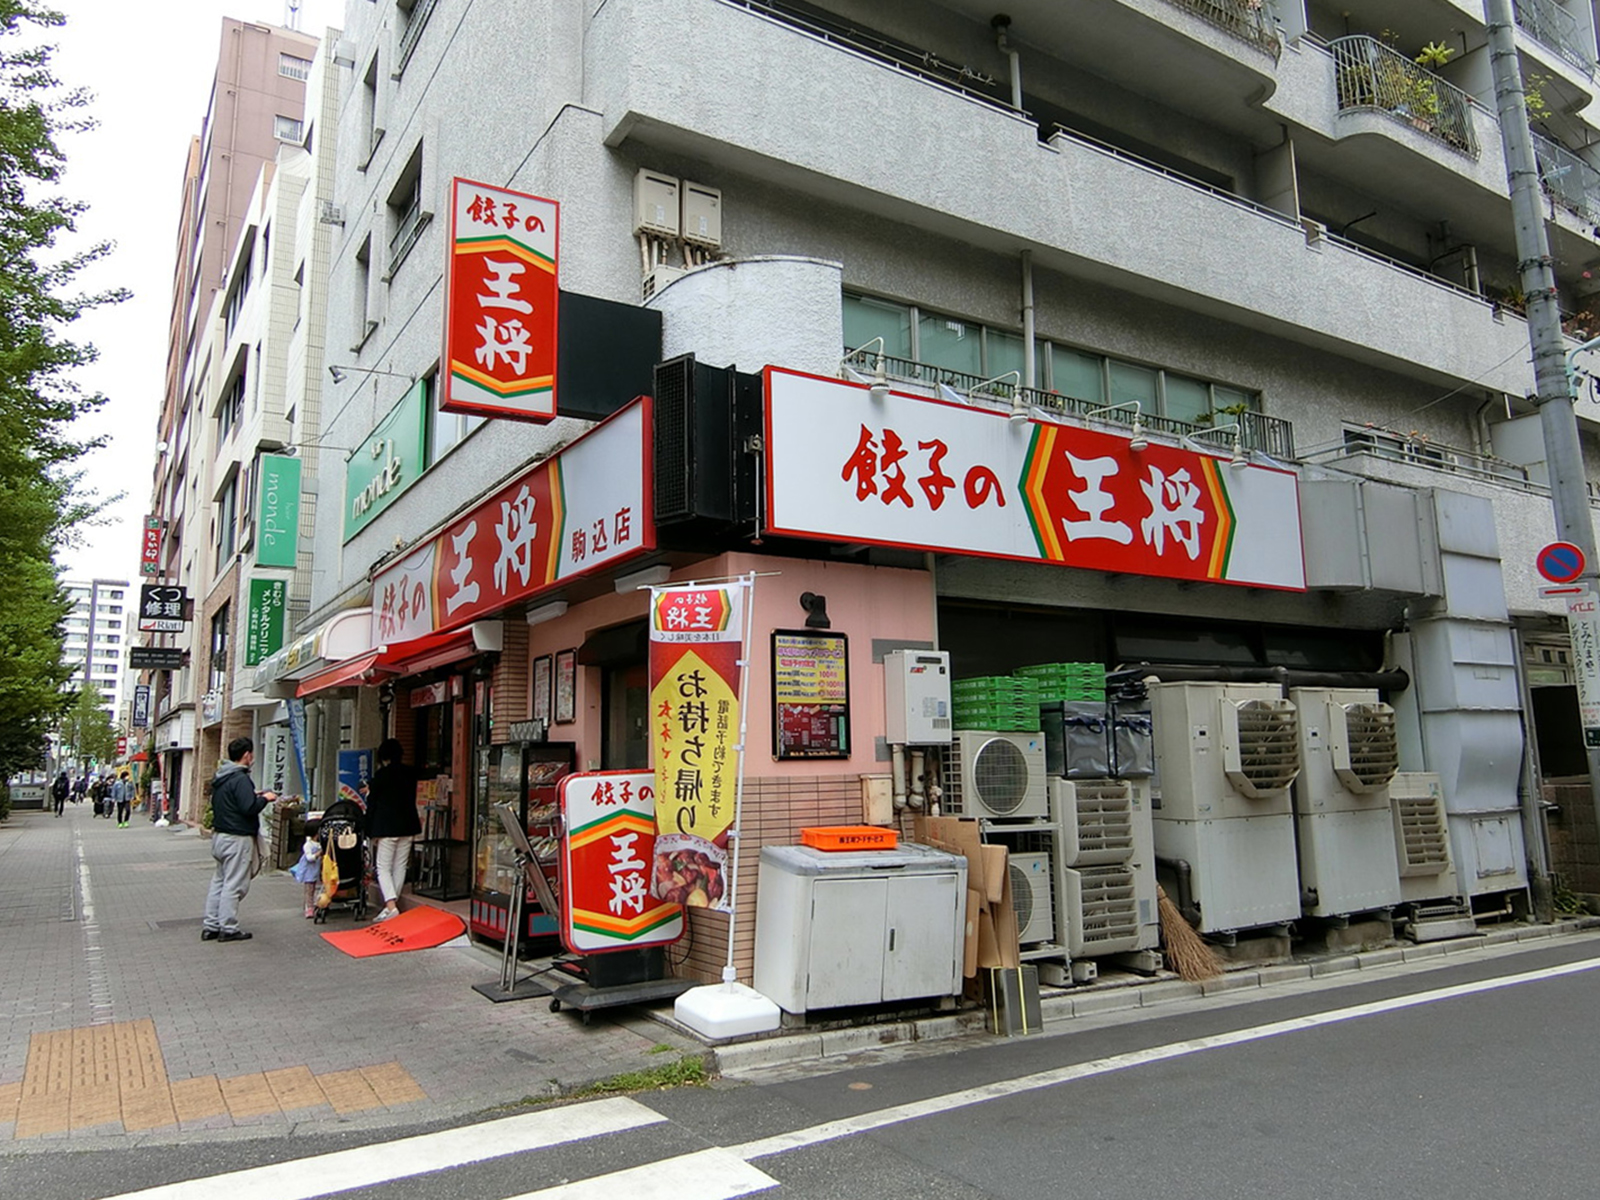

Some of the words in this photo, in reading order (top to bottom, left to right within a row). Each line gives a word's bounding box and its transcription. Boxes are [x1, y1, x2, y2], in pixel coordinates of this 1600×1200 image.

[467, 194, 545, 234] 餃子の
[474, 256, 534, 376] 王将
[352, 439, 402, 520] monde
[841, 423, 1006, 511] 餃子の
[264, 473, 286, 547] monde
[571, 506, 632, 564] 駒込店
[1062, 450, 1205, 561] 王将
[145, 531, 158, 560] なか卯
[446, 484, 537, 618] 王将
[145, 602, 181, 617] 修理
[148, 587, 182, 602] くつ
[378, 573, 425, 640] 餃子の
[591, 780, 655, 806] 餃子の
[608, 832, 647, 915] 王将
